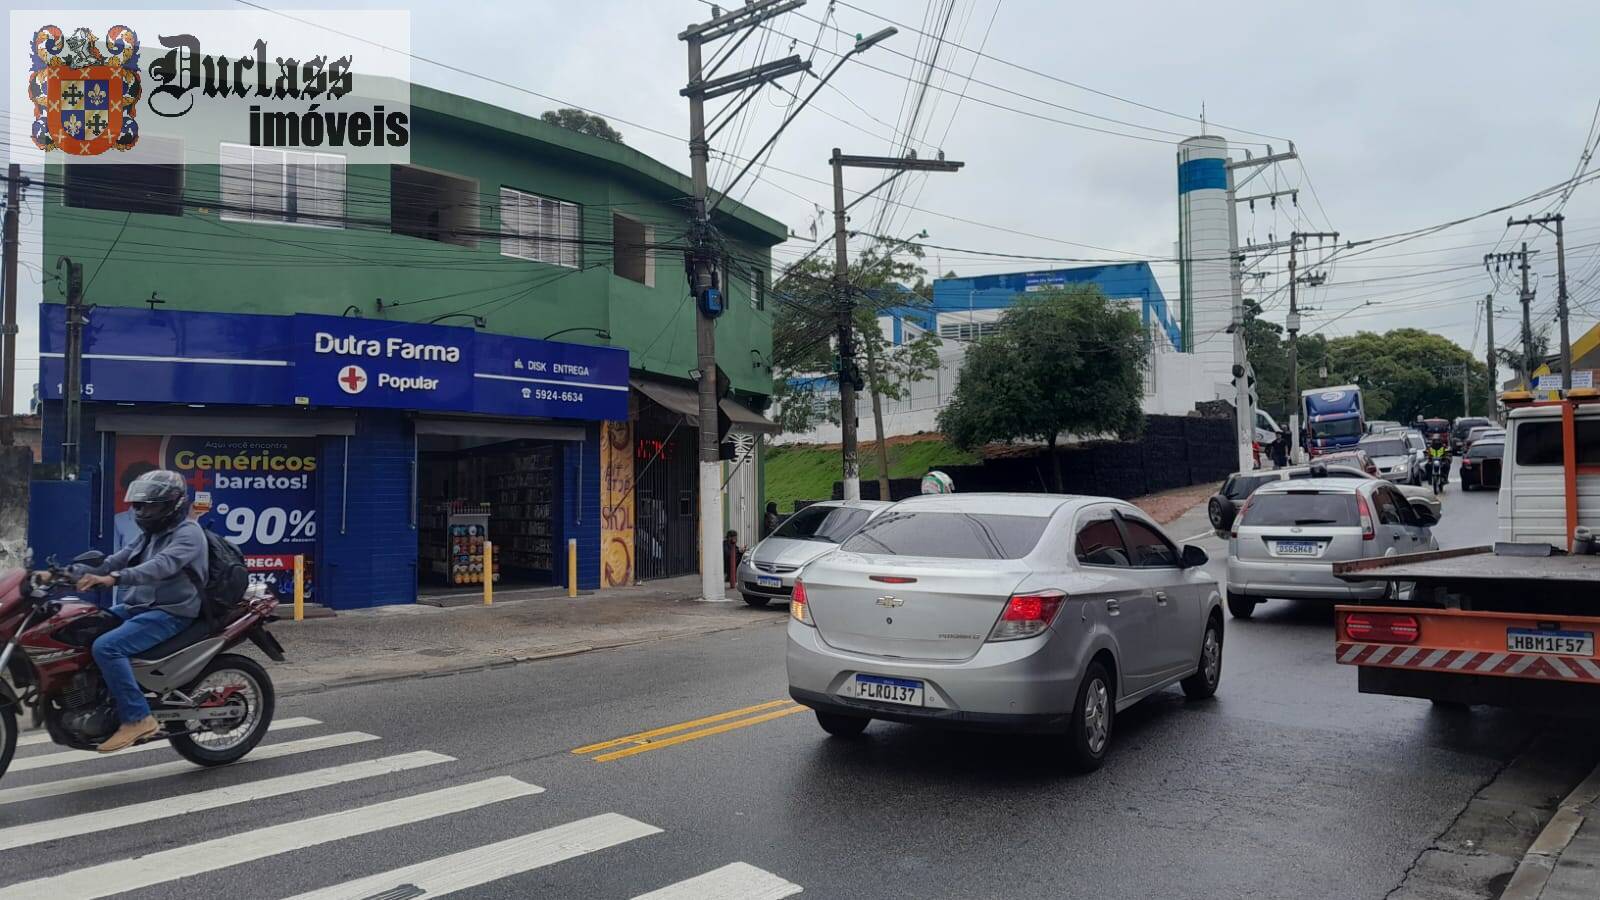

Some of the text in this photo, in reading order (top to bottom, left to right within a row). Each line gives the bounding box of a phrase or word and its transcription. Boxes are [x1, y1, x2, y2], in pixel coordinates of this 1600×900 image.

[315, 331, 460, 363] Dutra Farma
[527, 360, 590, 377] DISK ENTREGA
[56, 383, 94, 395] 15
[378, 373, 439, 392] Popular
[535, 388, 584, 402] 5924-6634
[204, 440, 226, 450] Aqui
[174, 449, 317, 472] Genéricos
[215, 473, 308, 490] baratos!
[224, 506, 317, 545] 90%
[247, 572, 277, 584] 634
[1515, 635, 1585, 653] HBM1F57
